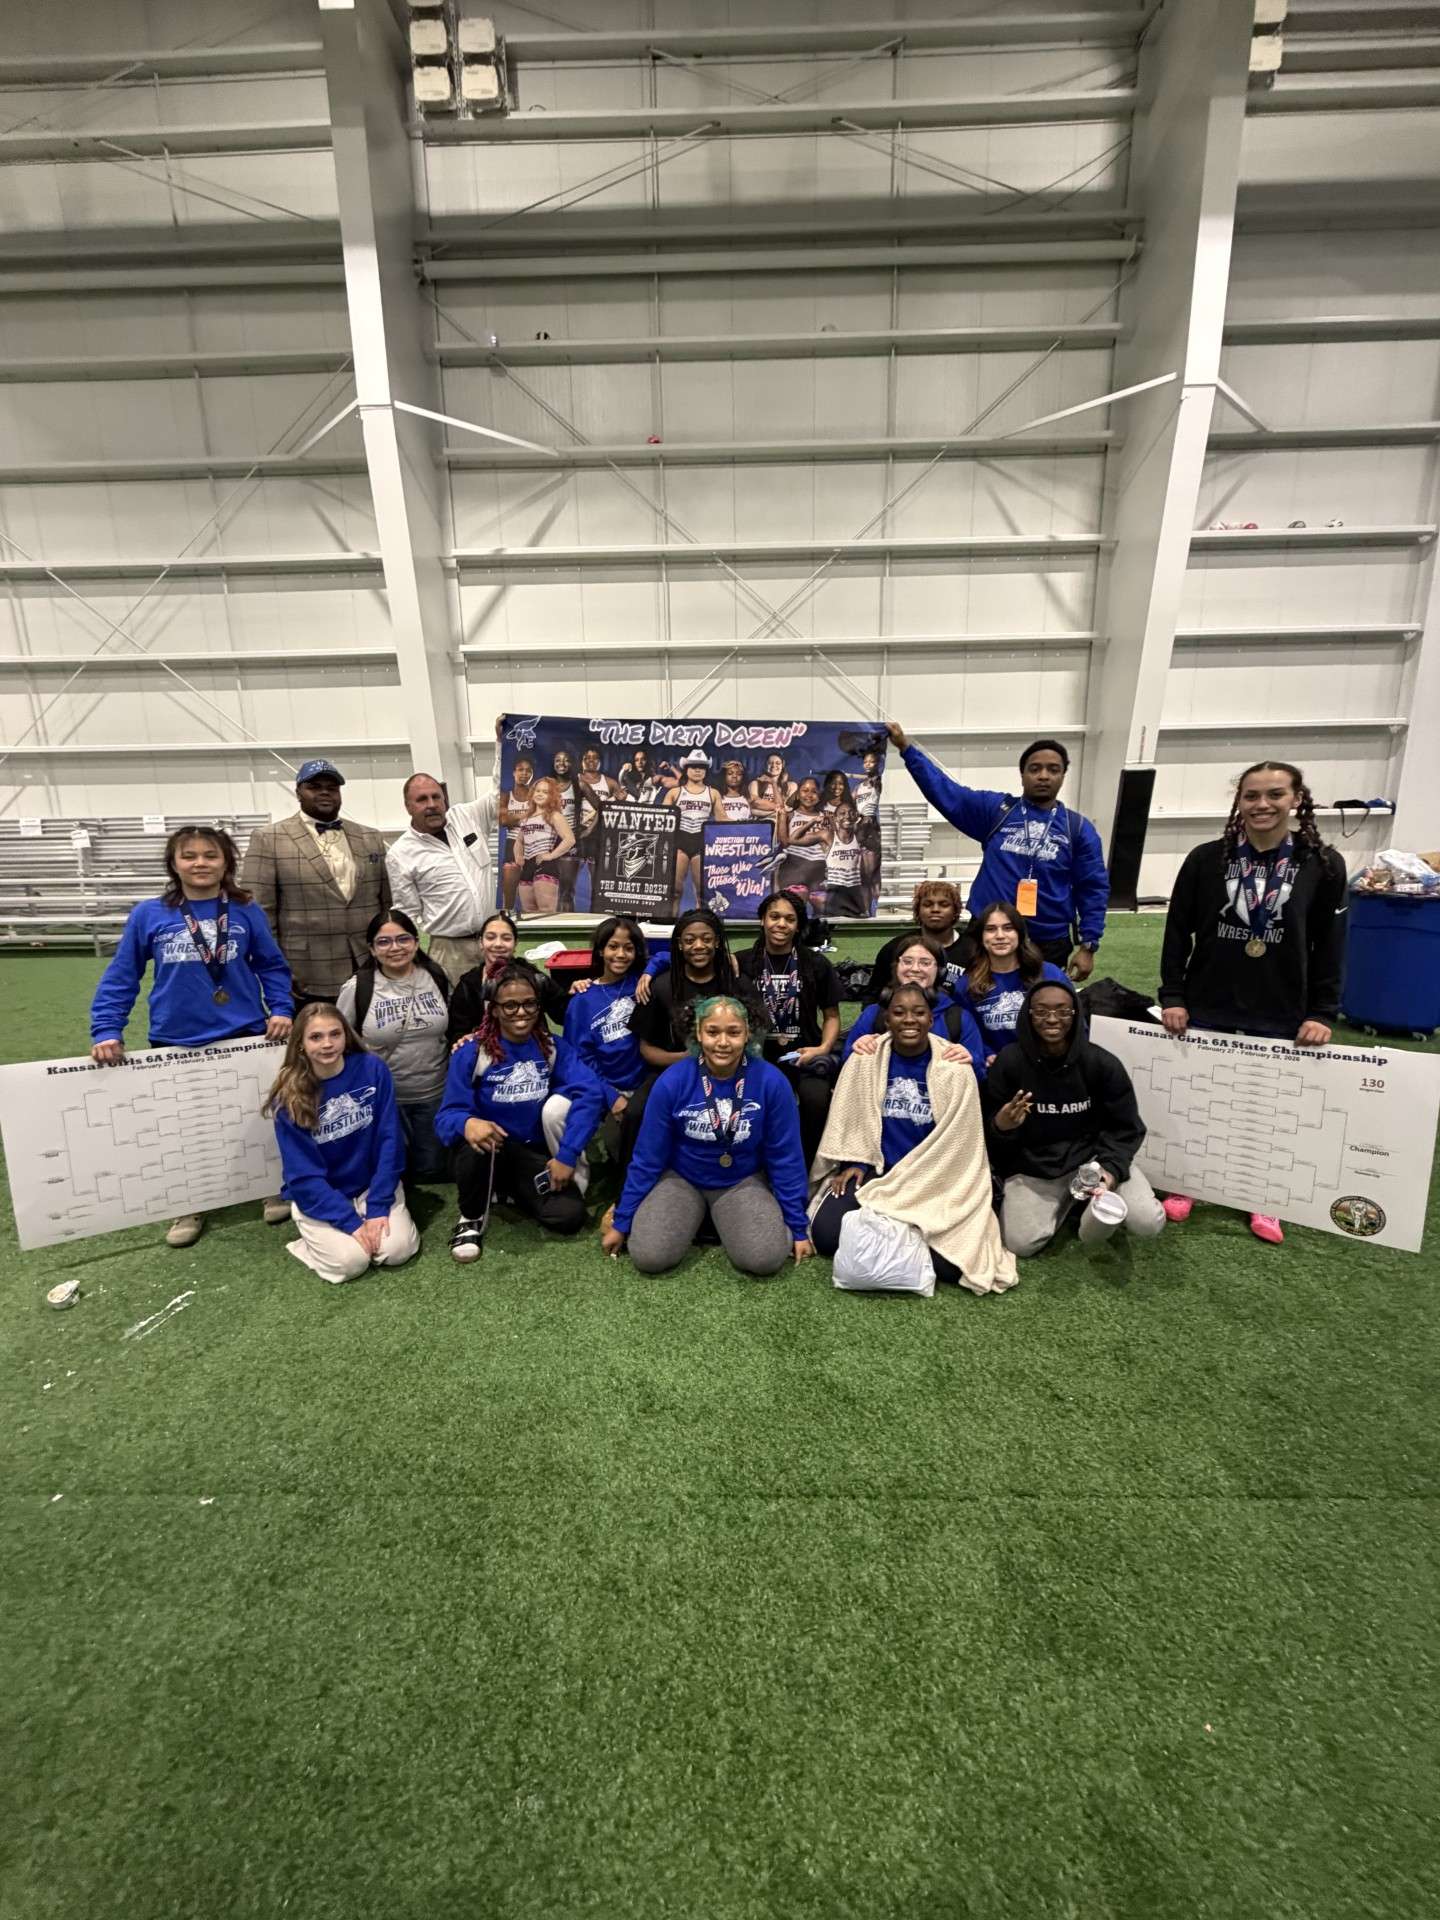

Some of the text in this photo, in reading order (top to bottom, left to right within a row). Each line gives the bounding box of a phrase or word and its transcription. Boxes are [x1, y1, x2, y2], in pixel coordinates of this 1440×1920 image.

[602, 811, 677, 833] WANTED
[745, 836, 760, 844] CITY
[705, 844, 771, 857] WRESTLING
[600, 880, 668, 894] THE DIRTY DOZEN
[946, 962, 966, 976] CITY
[1128, 1026, 1388, 1066] Kansas Girls 6A State Championship
[47, 1062, 104, 1076] Kansas
[145, 1054, 164, 1066] 6A
[166, 1049, 201, 1063] State
[204, 1039, 288, 1058] Championsh
[1361, 1078, 1385, 1088] 130
[884, 1098, 932, 1115] RESTLING
[1037, 1103, 1060, 1114] U.S.
[1349, 1145, 1390, 1157] Champion
